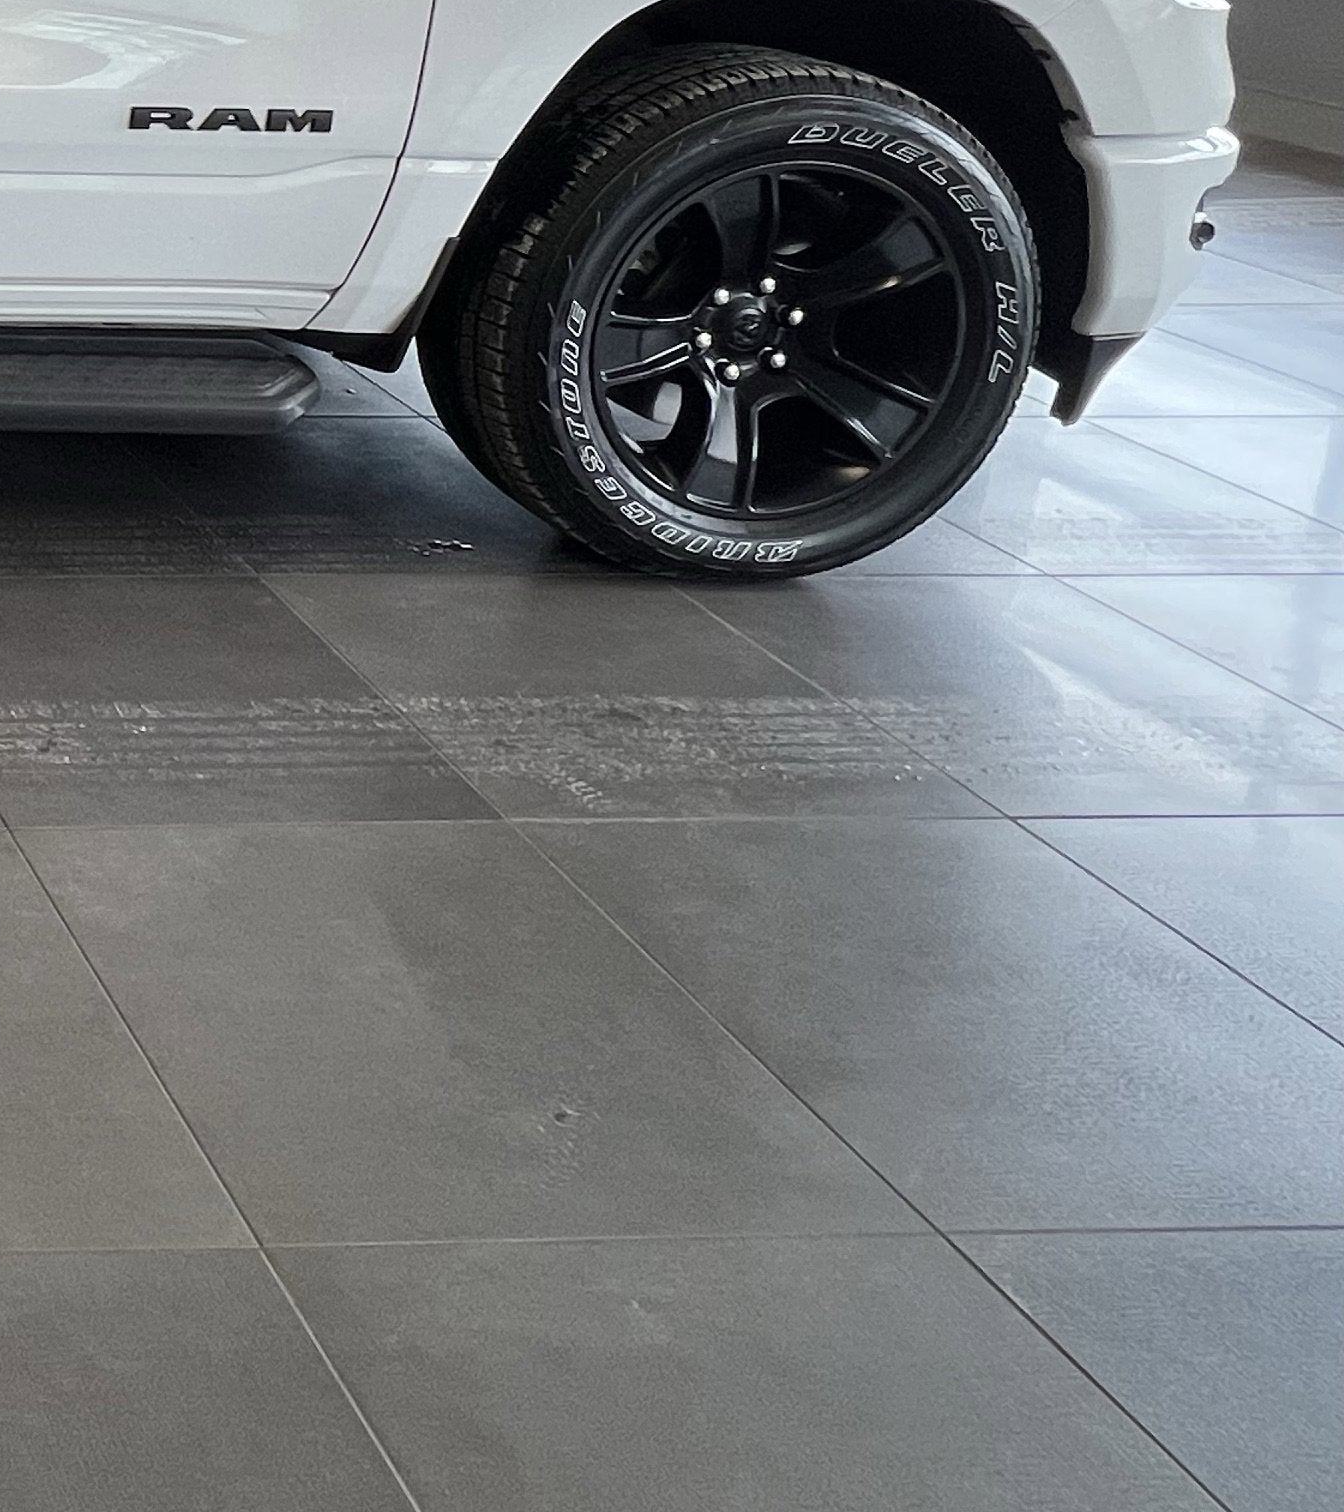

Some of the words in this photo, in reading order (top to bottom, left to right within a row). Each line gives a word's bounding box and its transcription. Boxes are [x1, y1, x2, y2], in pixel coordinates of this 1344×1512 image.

[128, 106, 335, 133] RAM
[787, 121, 1005, 254] DUELER
[988, 280, 1021, 384] H/L
[559, 299, 805, 564] BRIDGESTONE
